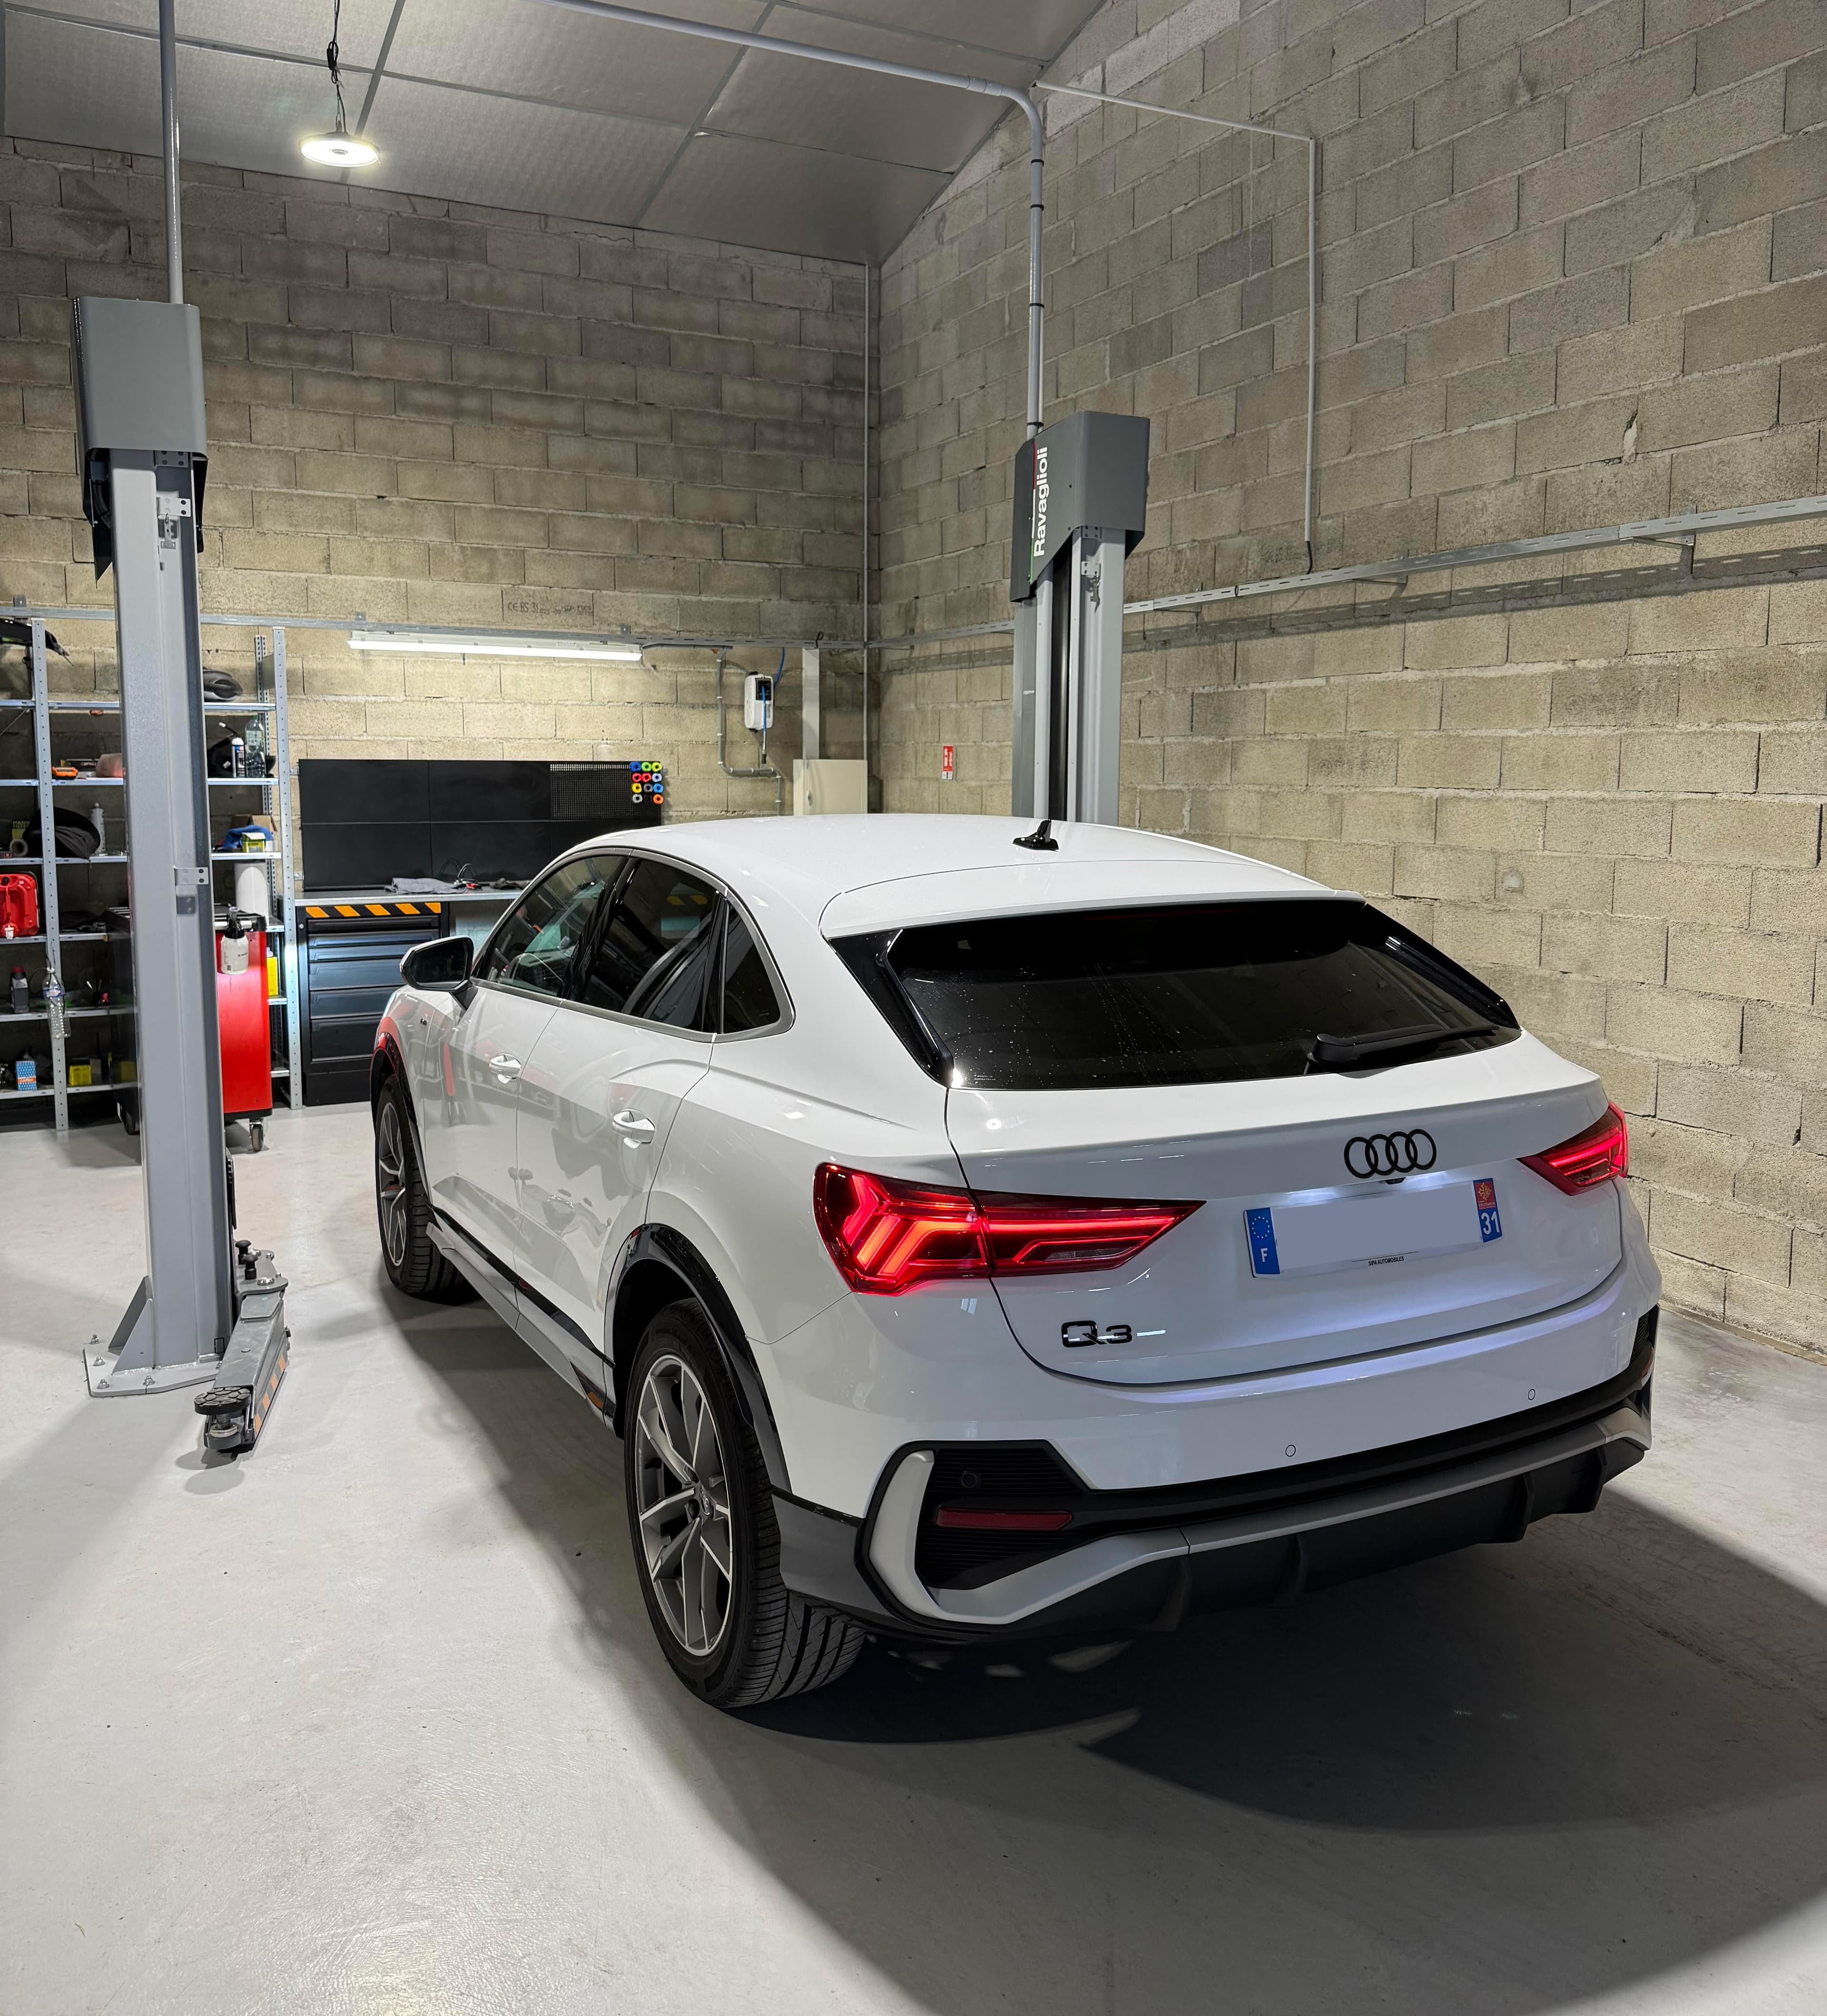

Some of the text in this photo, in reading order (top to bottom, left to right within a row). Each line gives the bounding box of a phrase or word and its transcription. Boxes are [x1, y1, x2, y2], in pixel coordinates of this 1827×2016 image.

[1033, 447, 1050, 557] Ravaglioli
[1481, 1211, 1500, 1235] 31
[1261, 1248, 1268, 1262] F
[1377, 1256, 1405, 1265] AUTOMOBILES
[1061, 1320, 1132, 1347] Q3
